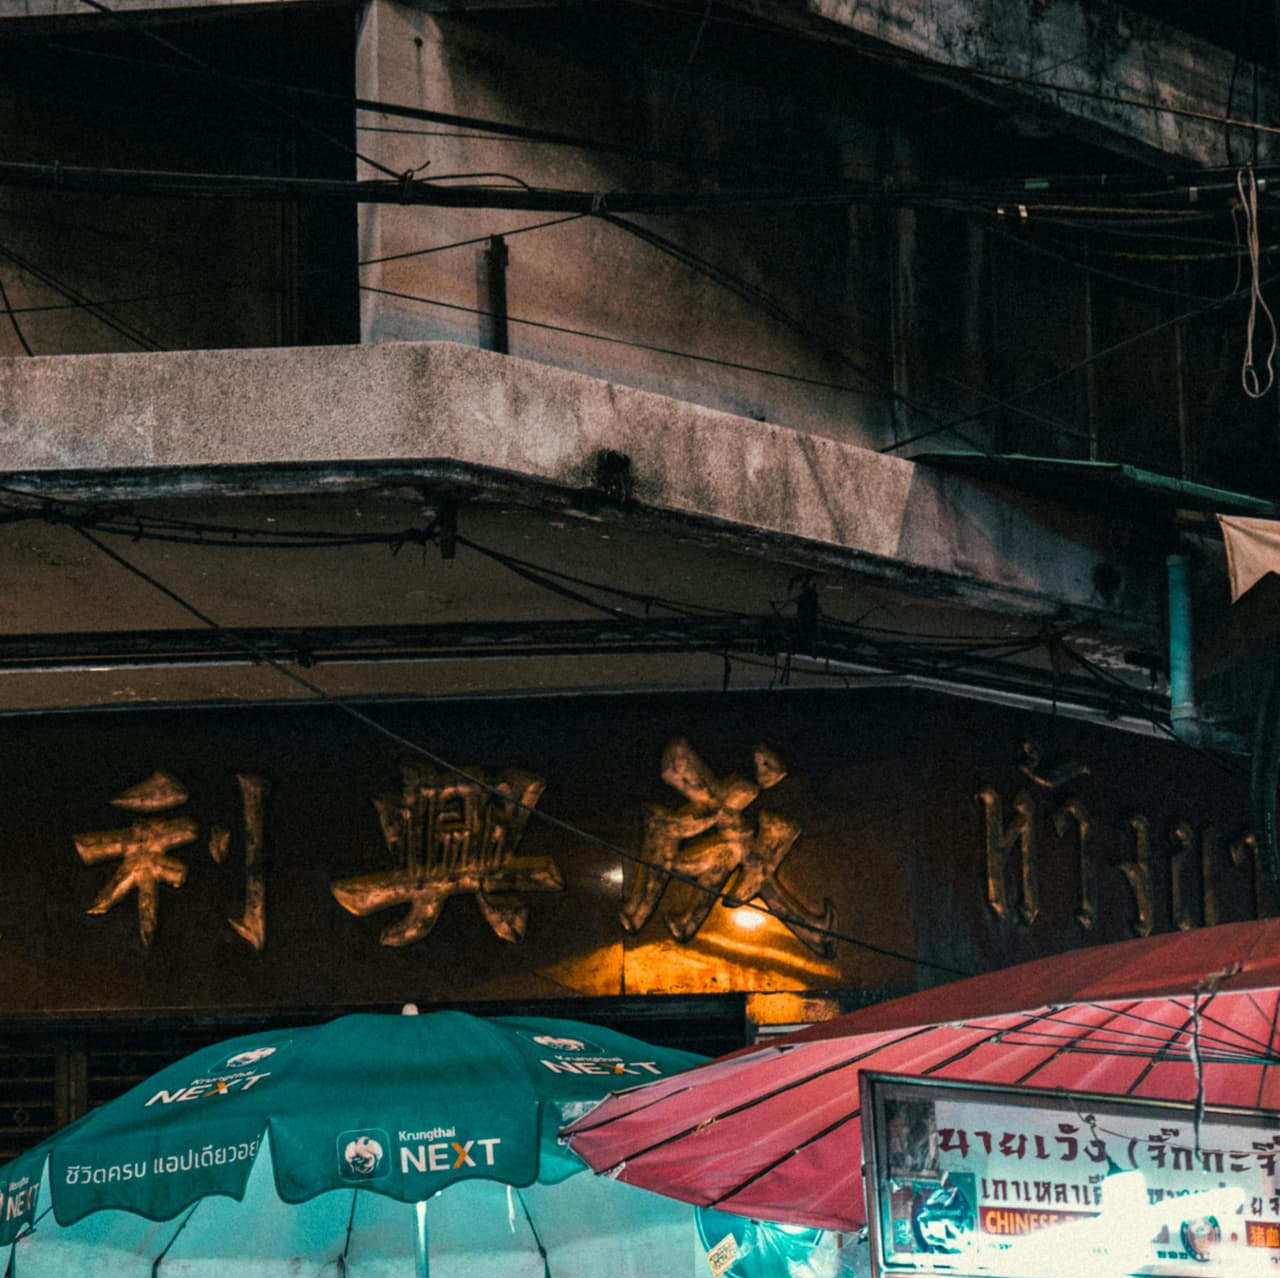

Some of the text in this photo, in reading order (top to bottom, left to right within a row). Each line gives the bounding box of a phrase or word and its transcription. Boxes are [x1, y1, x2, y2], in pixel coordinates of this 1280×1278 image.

[539, 1059, 662, 1075] NEXT
[144, 1072, 272, 1106] NEXT
[398, 1126, 457, 1142] Krungthai
[400, 1138, 502, 1174] NEXT
[65, 1161, 148, 1185] ชีวิตครบ
